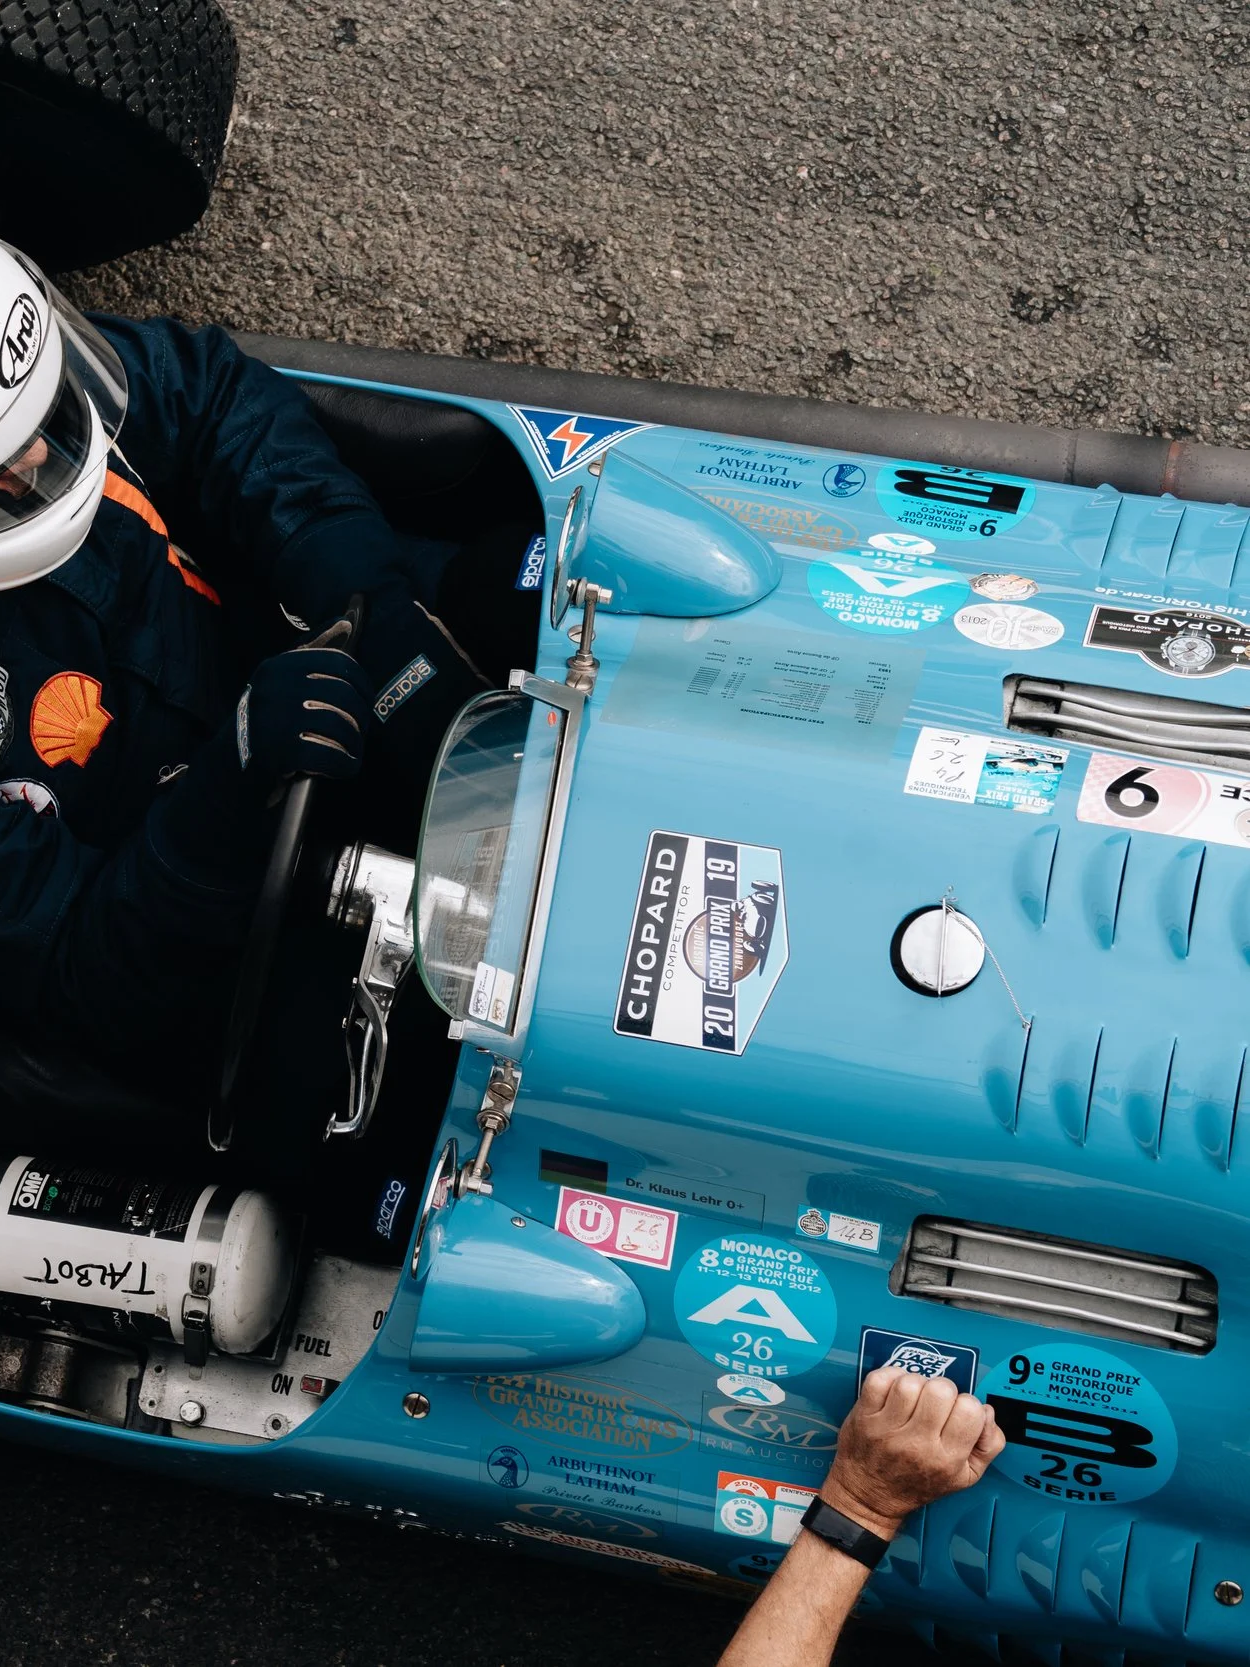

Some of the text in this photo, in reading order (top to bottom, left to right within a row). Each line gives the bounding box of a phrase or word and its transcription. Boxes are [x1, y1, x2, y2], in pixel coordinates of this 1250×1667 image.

[5, 298, 36, 368] Arai
[695, 465, 803, 490] ARBUTHNOT
[717, 456, 788, 476] LATHAM
[894, 469, 1026, 515] B
[896, 516, 923, 525] PRIX
[902, 510, 966, 527] HISTORIQUE
[920, 506, 968, 519] MONACO
[926, 520, 964, 533] GRAND
[873, 558, 915, 573] 26
[827, 562, 956, 597] A
[821, 589, 854, 600] 2012
[827, 597, 905, 611] HISTORIQUE
[859, 595, 884, 603] MAI
[822, 601, 853, 612] PRIX
[857, 607, 904, 618] GRAND
[838, 611, 920, 630] MONACO
[961, 615, 988, 625] 2013
[377, 659, 431, 716] sparco
[908, 785, 971, 800] VERIFICATIONS
[913, 780, 968, 794] TECHNIQUES
[985, 789, 1009, 802] PRIX
[1012, 793, 1048, 807] GRAND
[627, 848, 676, 1020] CHOPARD
[663, 884, 690, 991] COMPETITOR
[709, 901, 730, 991] GRAND PRIX
[18, 1171, 43, 1208] OMP
[625, 1178, 644, 1190] Dr.
[648, 1182, 687, 1199] Klaus
[691, 1192, 723, 1207] Lehr
[376, 1180, 406, 1239] sparco
[579, 1200, 605, 1211] 2016
[579, 1208, 602, 1232] U
[721, 1239, 802, 1263] MONACO
[21, 1257, 156, 1296] TALBOT
[736, 1264, 814, 1284] HISTORIQUE
[737, 1256, 784, 1270] GRAND
[790, 1265, 819, 1277] PRIX
[696, 1266, 822, 1294] 11-12-13 MAI 2012
[686, 1284, 819, 1344] A
[295, 1334, 332, 1357] FUEL
[732, 1332, 773, 1360] 26
[714, 1352, 789, 1376] SERIE
[897, 1351, 947, 1369] L'AGE
[1008, 1354, 1141, 1387] 9e GRAND PRIX
[271, 1373, 294, 1396] ON
[1048, 1383, 1112, 1404] MONACO
[1050, 1372, 1134, 1397] HISTORIQUE
[488, 1385, 678, 1439] GRAND PRIX CARS
[1067, 1398, 1096, 1407] MAI
[1101, 1404, 1139, 1415] 2014
[513, 1408, 651, 1452] ASSOCIATION
[738, 1409, 821, 1447] RM
[986, 1393, 1158, 1469] B
[705, 1438, 832, 1468] RM AUCTIO
[546, 1455, 656, 1485] ARBUTHNOT
[1039, 1454, 1103, 1487] 26
[565, 1473, 637, 1496] LATHAM
[733, 1480, 760, 1491] 2012
[1022, 1473, 1117, 1502] SERIE
[541, 1485, 662, 1517] Private Bankers
[733, 1499, 758, 1509] 2014
[734, 1508, 754, 1527] S
